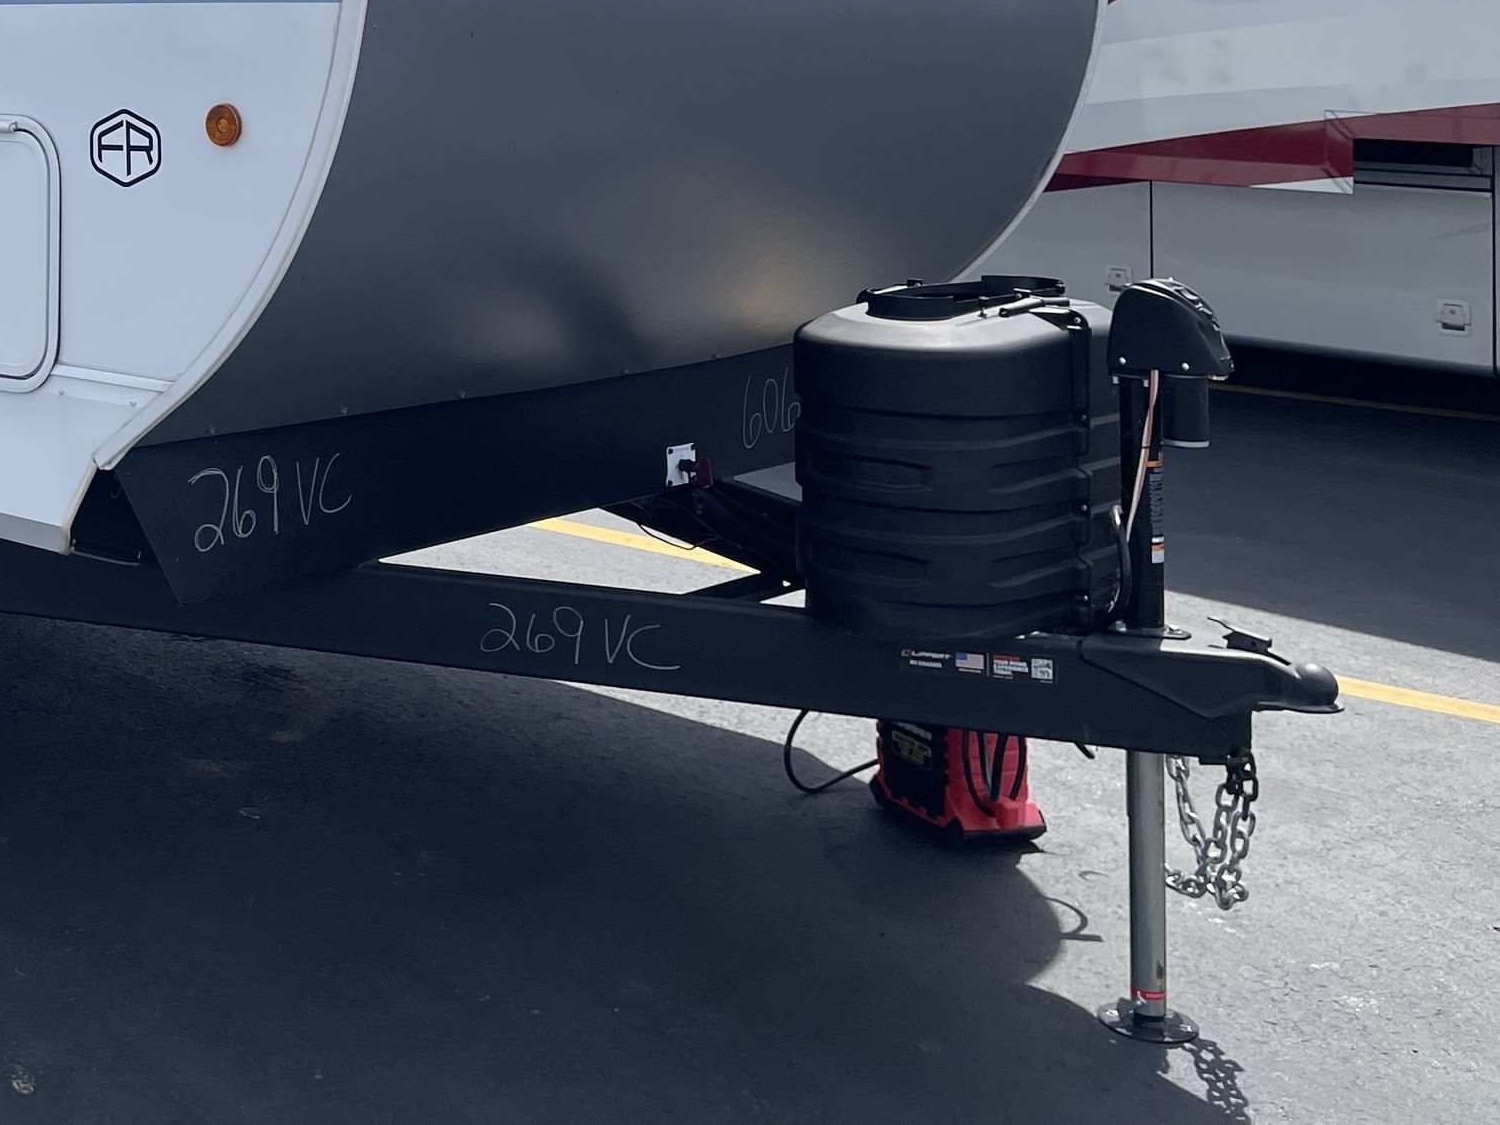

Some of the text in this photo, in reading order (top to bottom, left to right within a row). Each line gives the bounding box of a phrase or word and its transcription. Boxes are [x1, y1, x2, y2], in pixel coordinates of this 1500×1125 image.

[187, 452, 353, 553] 269 VC
[479, 602, 681, 671] 269 VC
